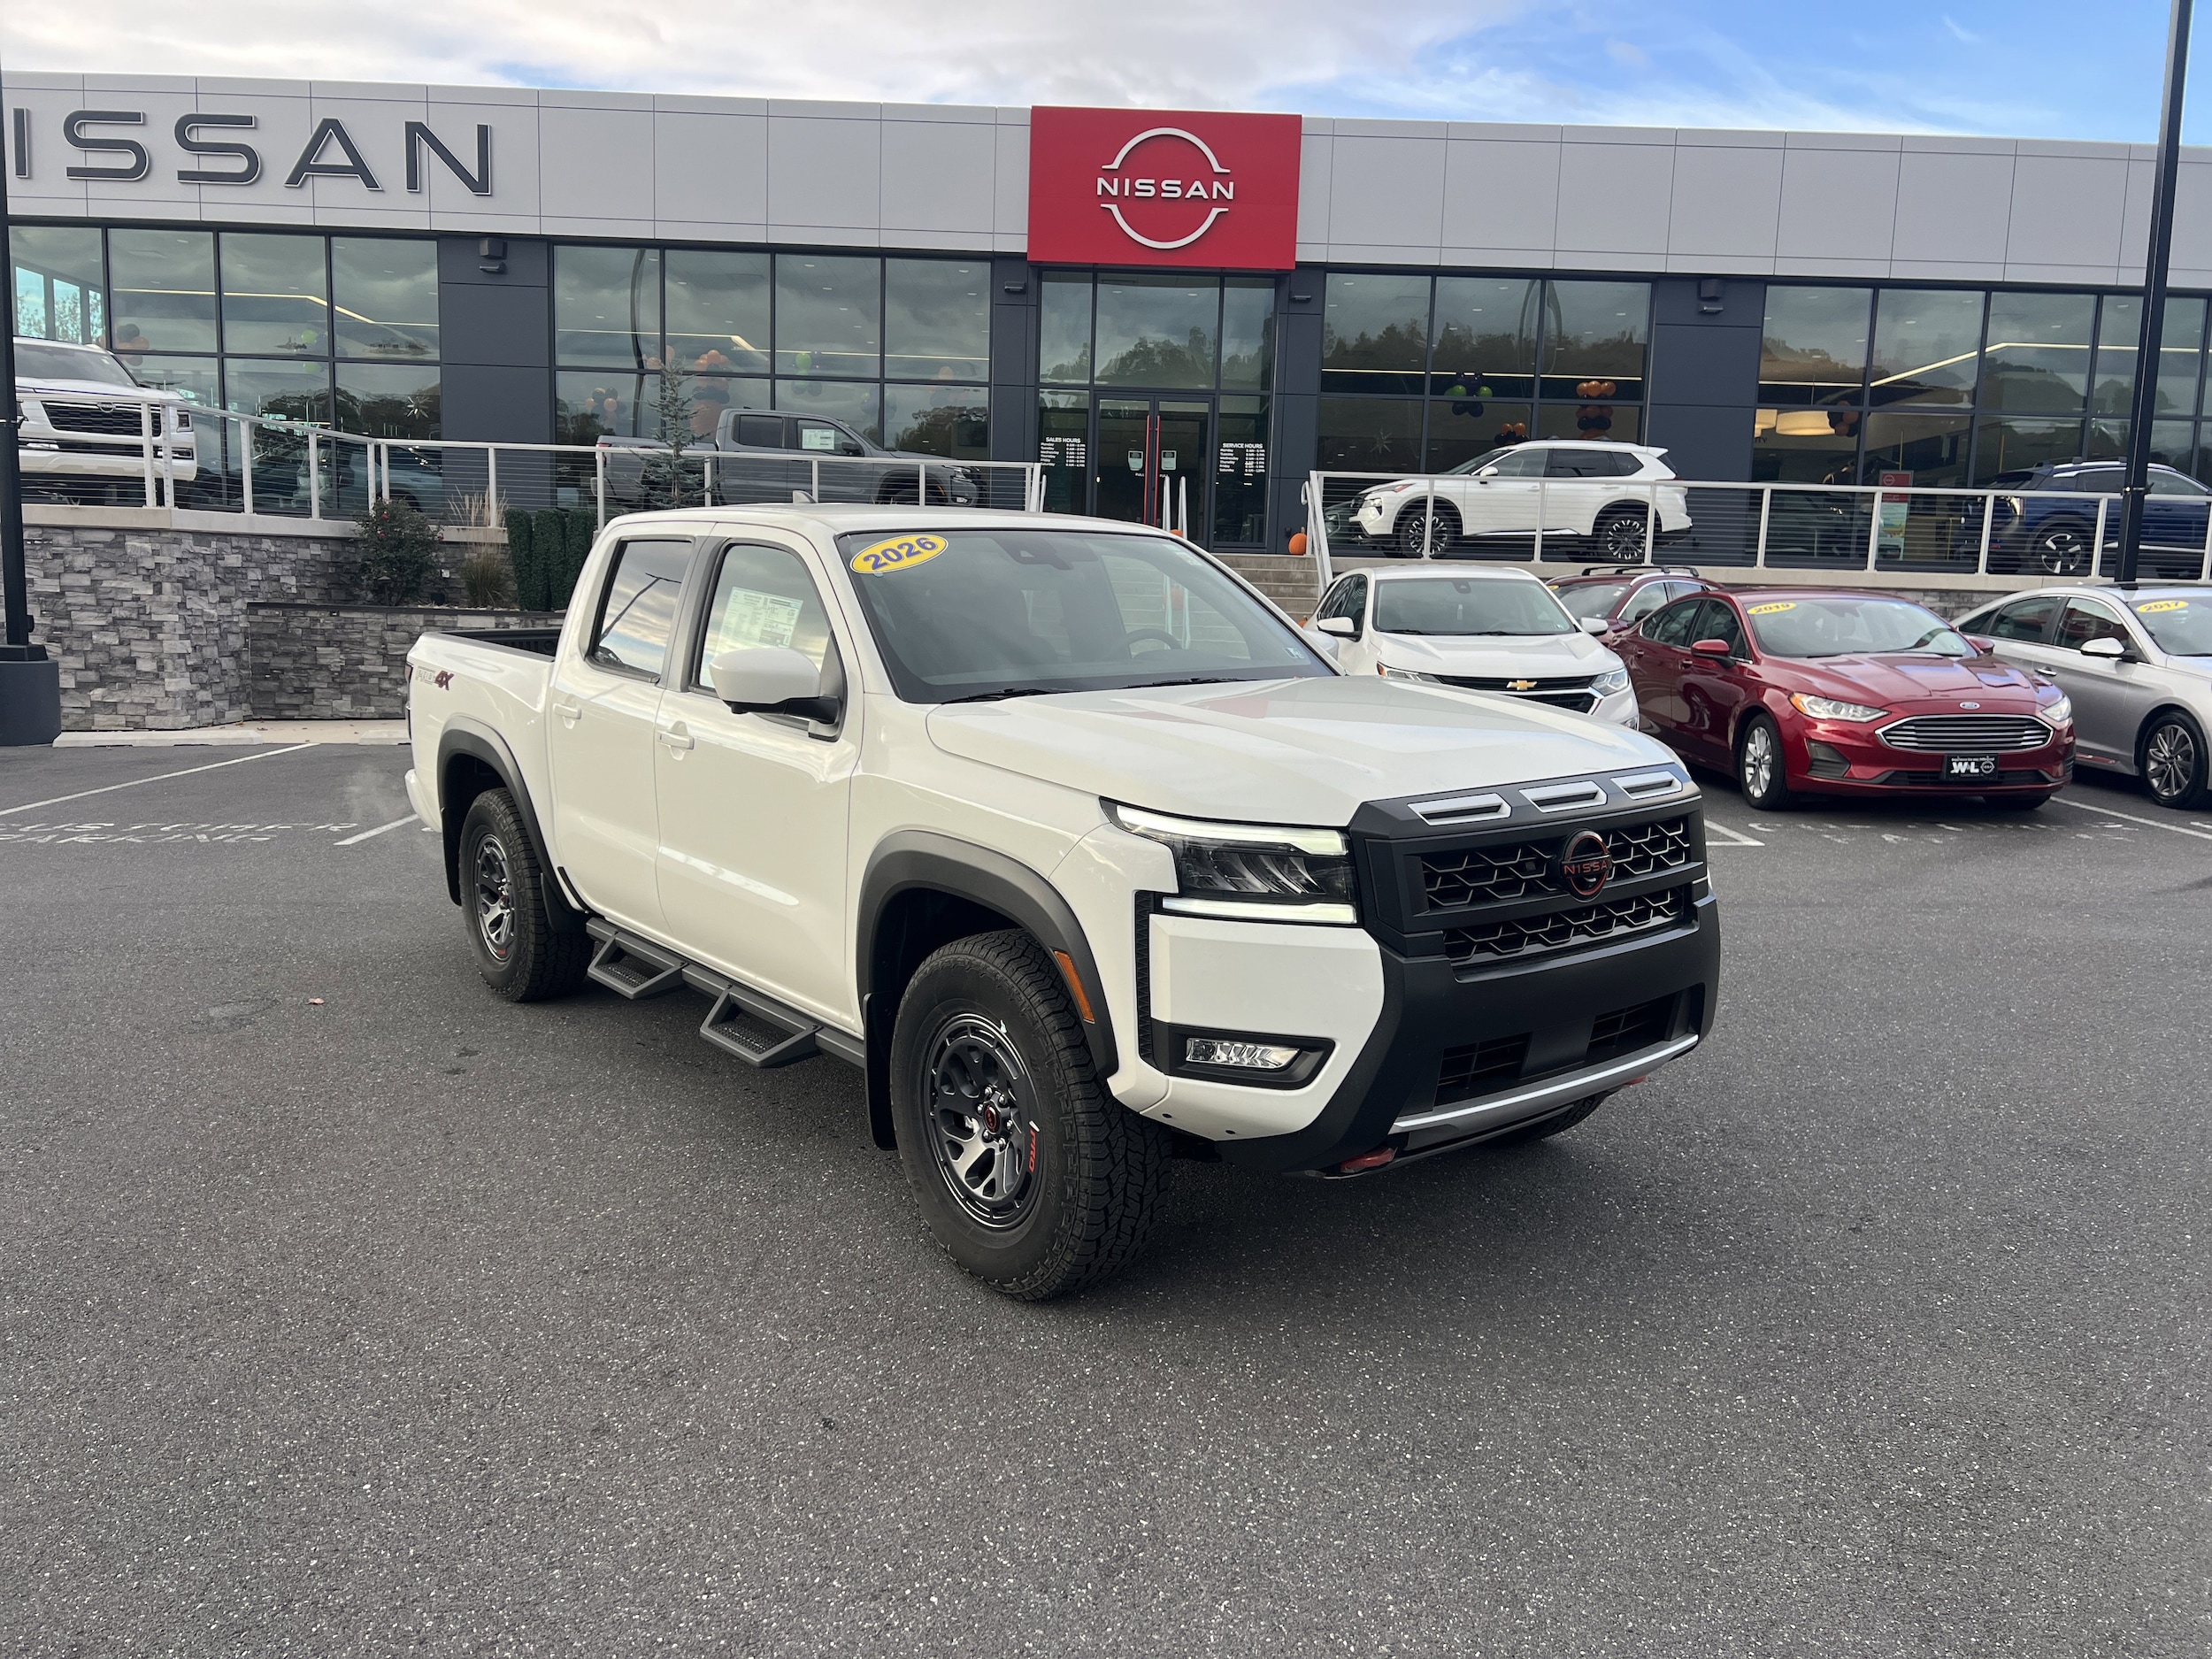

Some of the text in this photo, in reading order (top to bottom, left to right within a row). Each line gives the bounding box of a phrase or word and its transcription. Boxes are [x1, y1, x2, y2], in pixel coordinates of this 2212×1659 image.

[1096, 177, 1234, 200] NISSAN
[864, 537, 939, 571] 2026
[2145, 601, 2179, 611] 2017
[1563, 859, 1608, 874] NISSA
